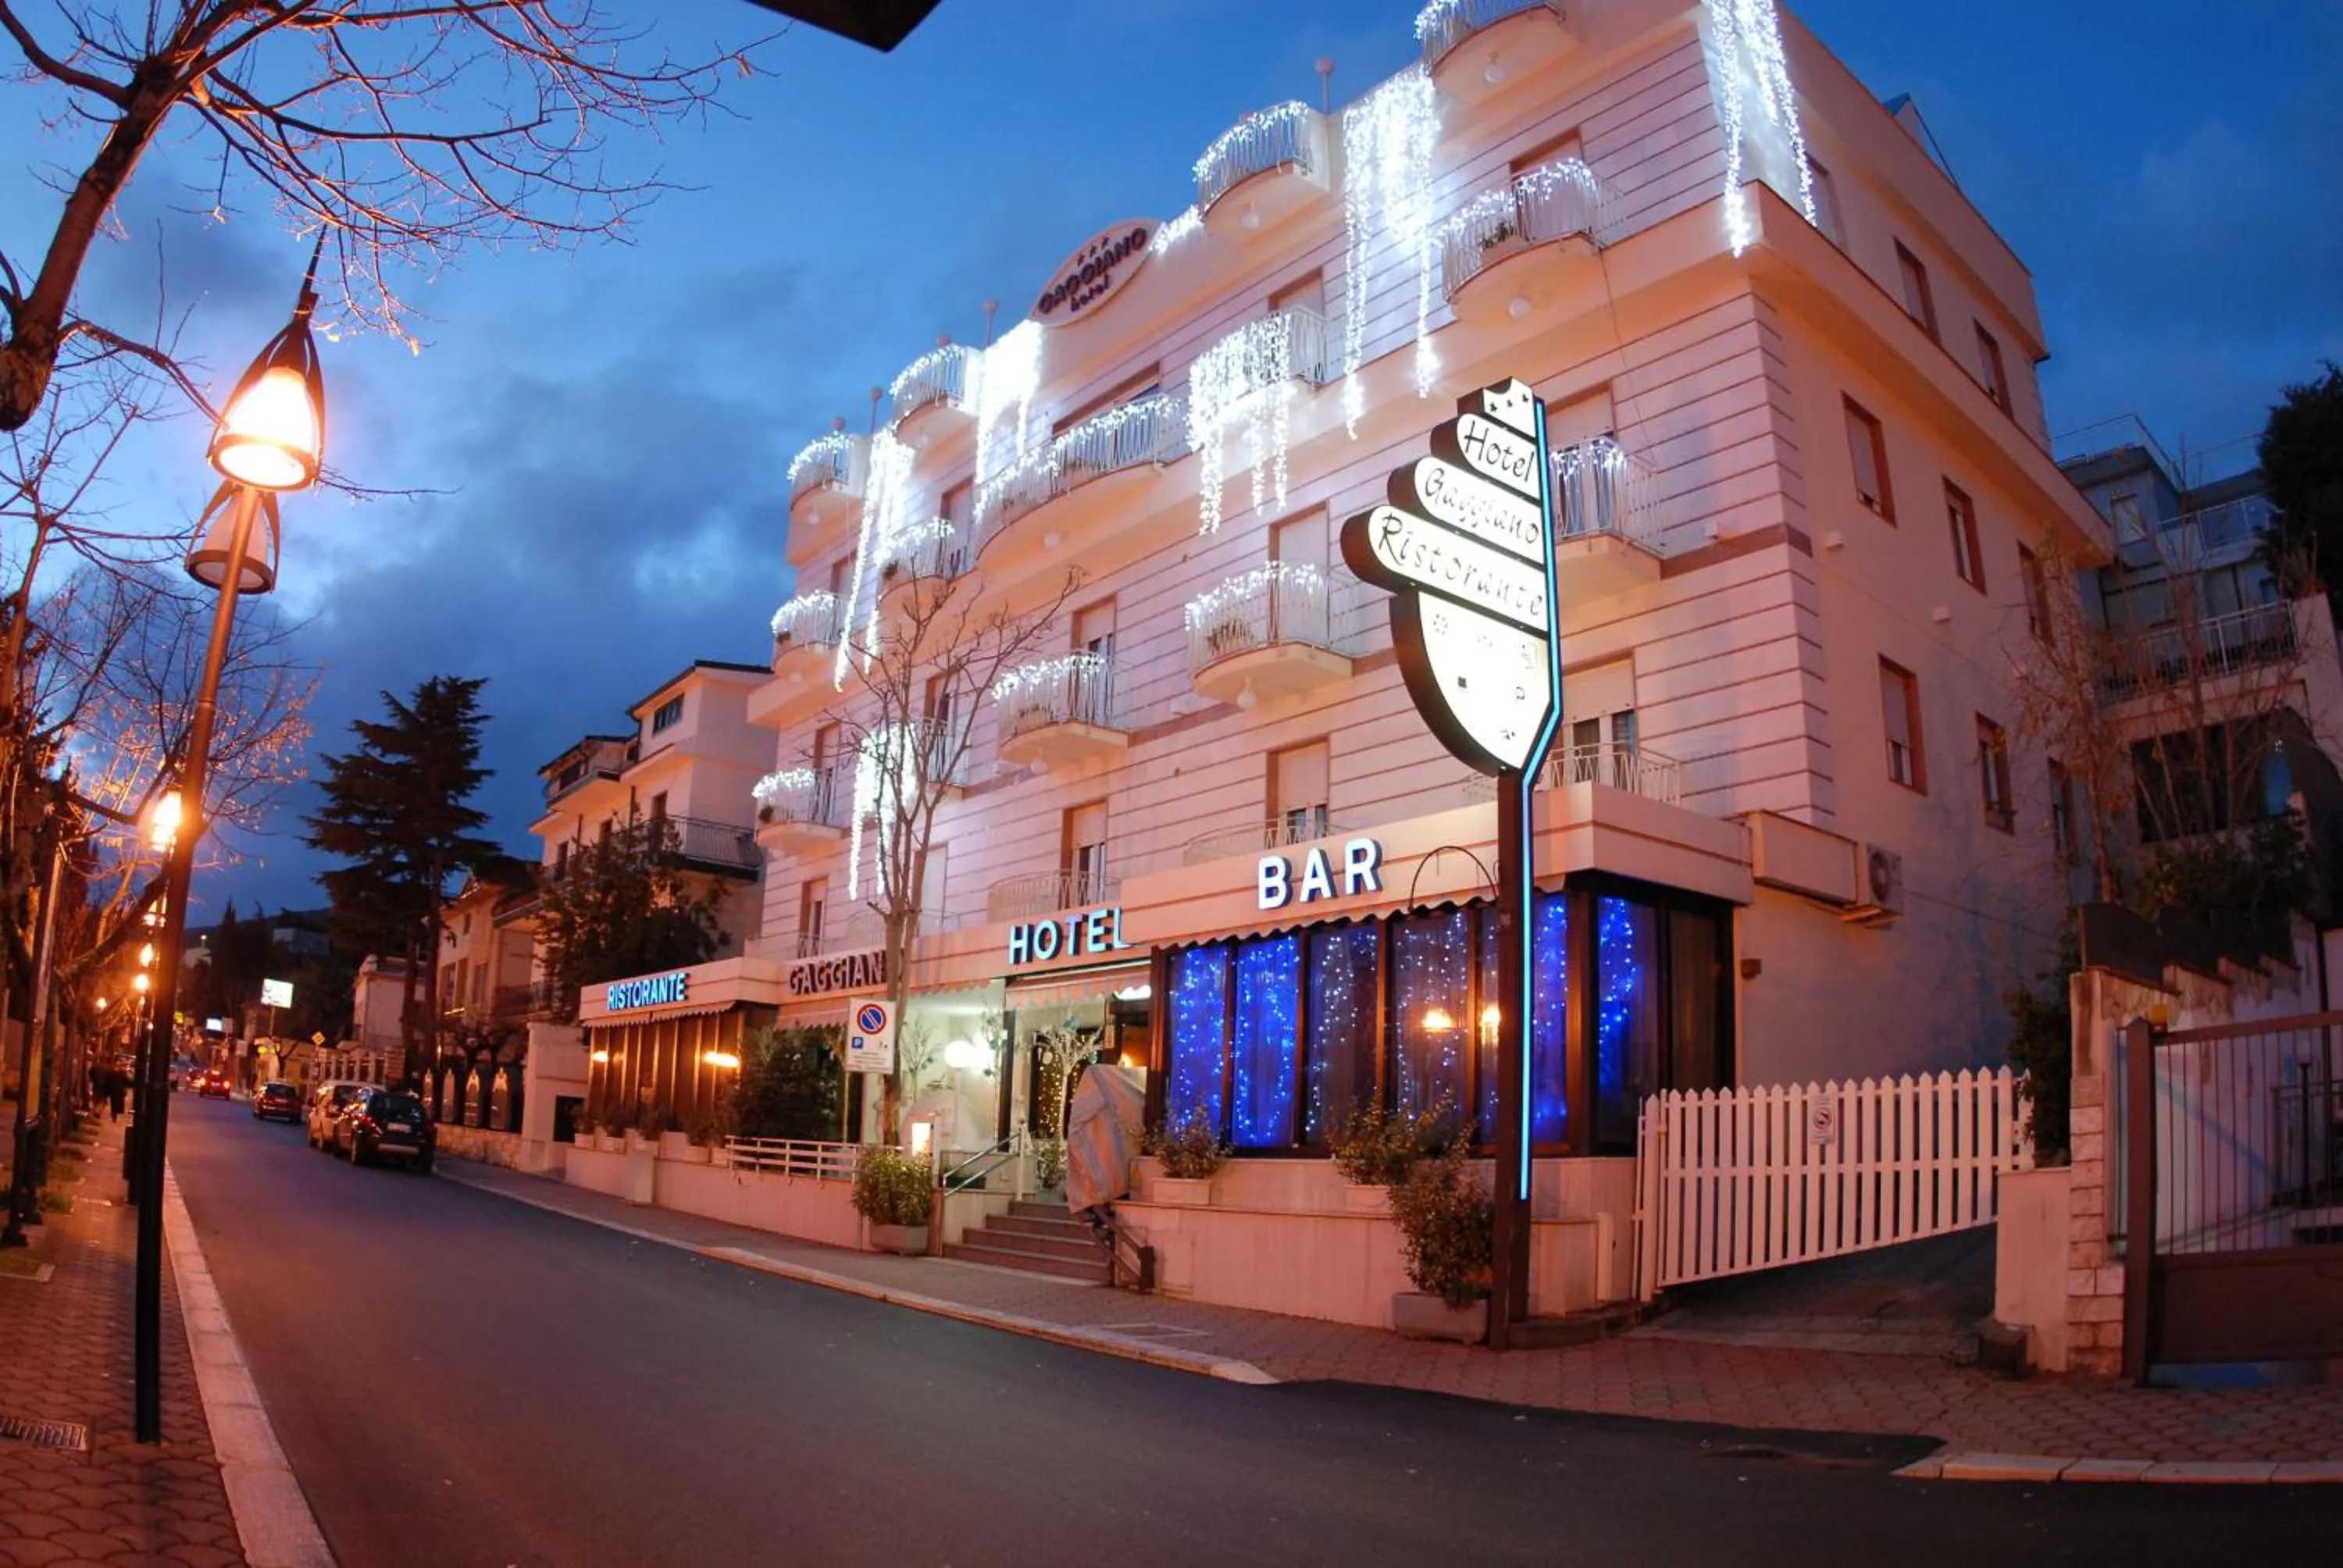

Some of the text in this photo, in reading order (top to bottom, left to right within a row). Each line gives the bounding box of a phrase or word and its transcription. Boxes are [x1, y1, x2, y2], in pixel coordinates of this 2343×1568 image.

[1463, 420, 1535, 483] Hotel
[1424, 467, 1540, 544] Gaggiano
[1378, 512, 1543, 616] Ristorante
[1257, 838, 1381, 911] BAR
[1007, 907, 1132, 966] HOTEL
[607, 972, 689, 1011] RISTORANTE
[790, 949, 904, 996] GAGGIAN
